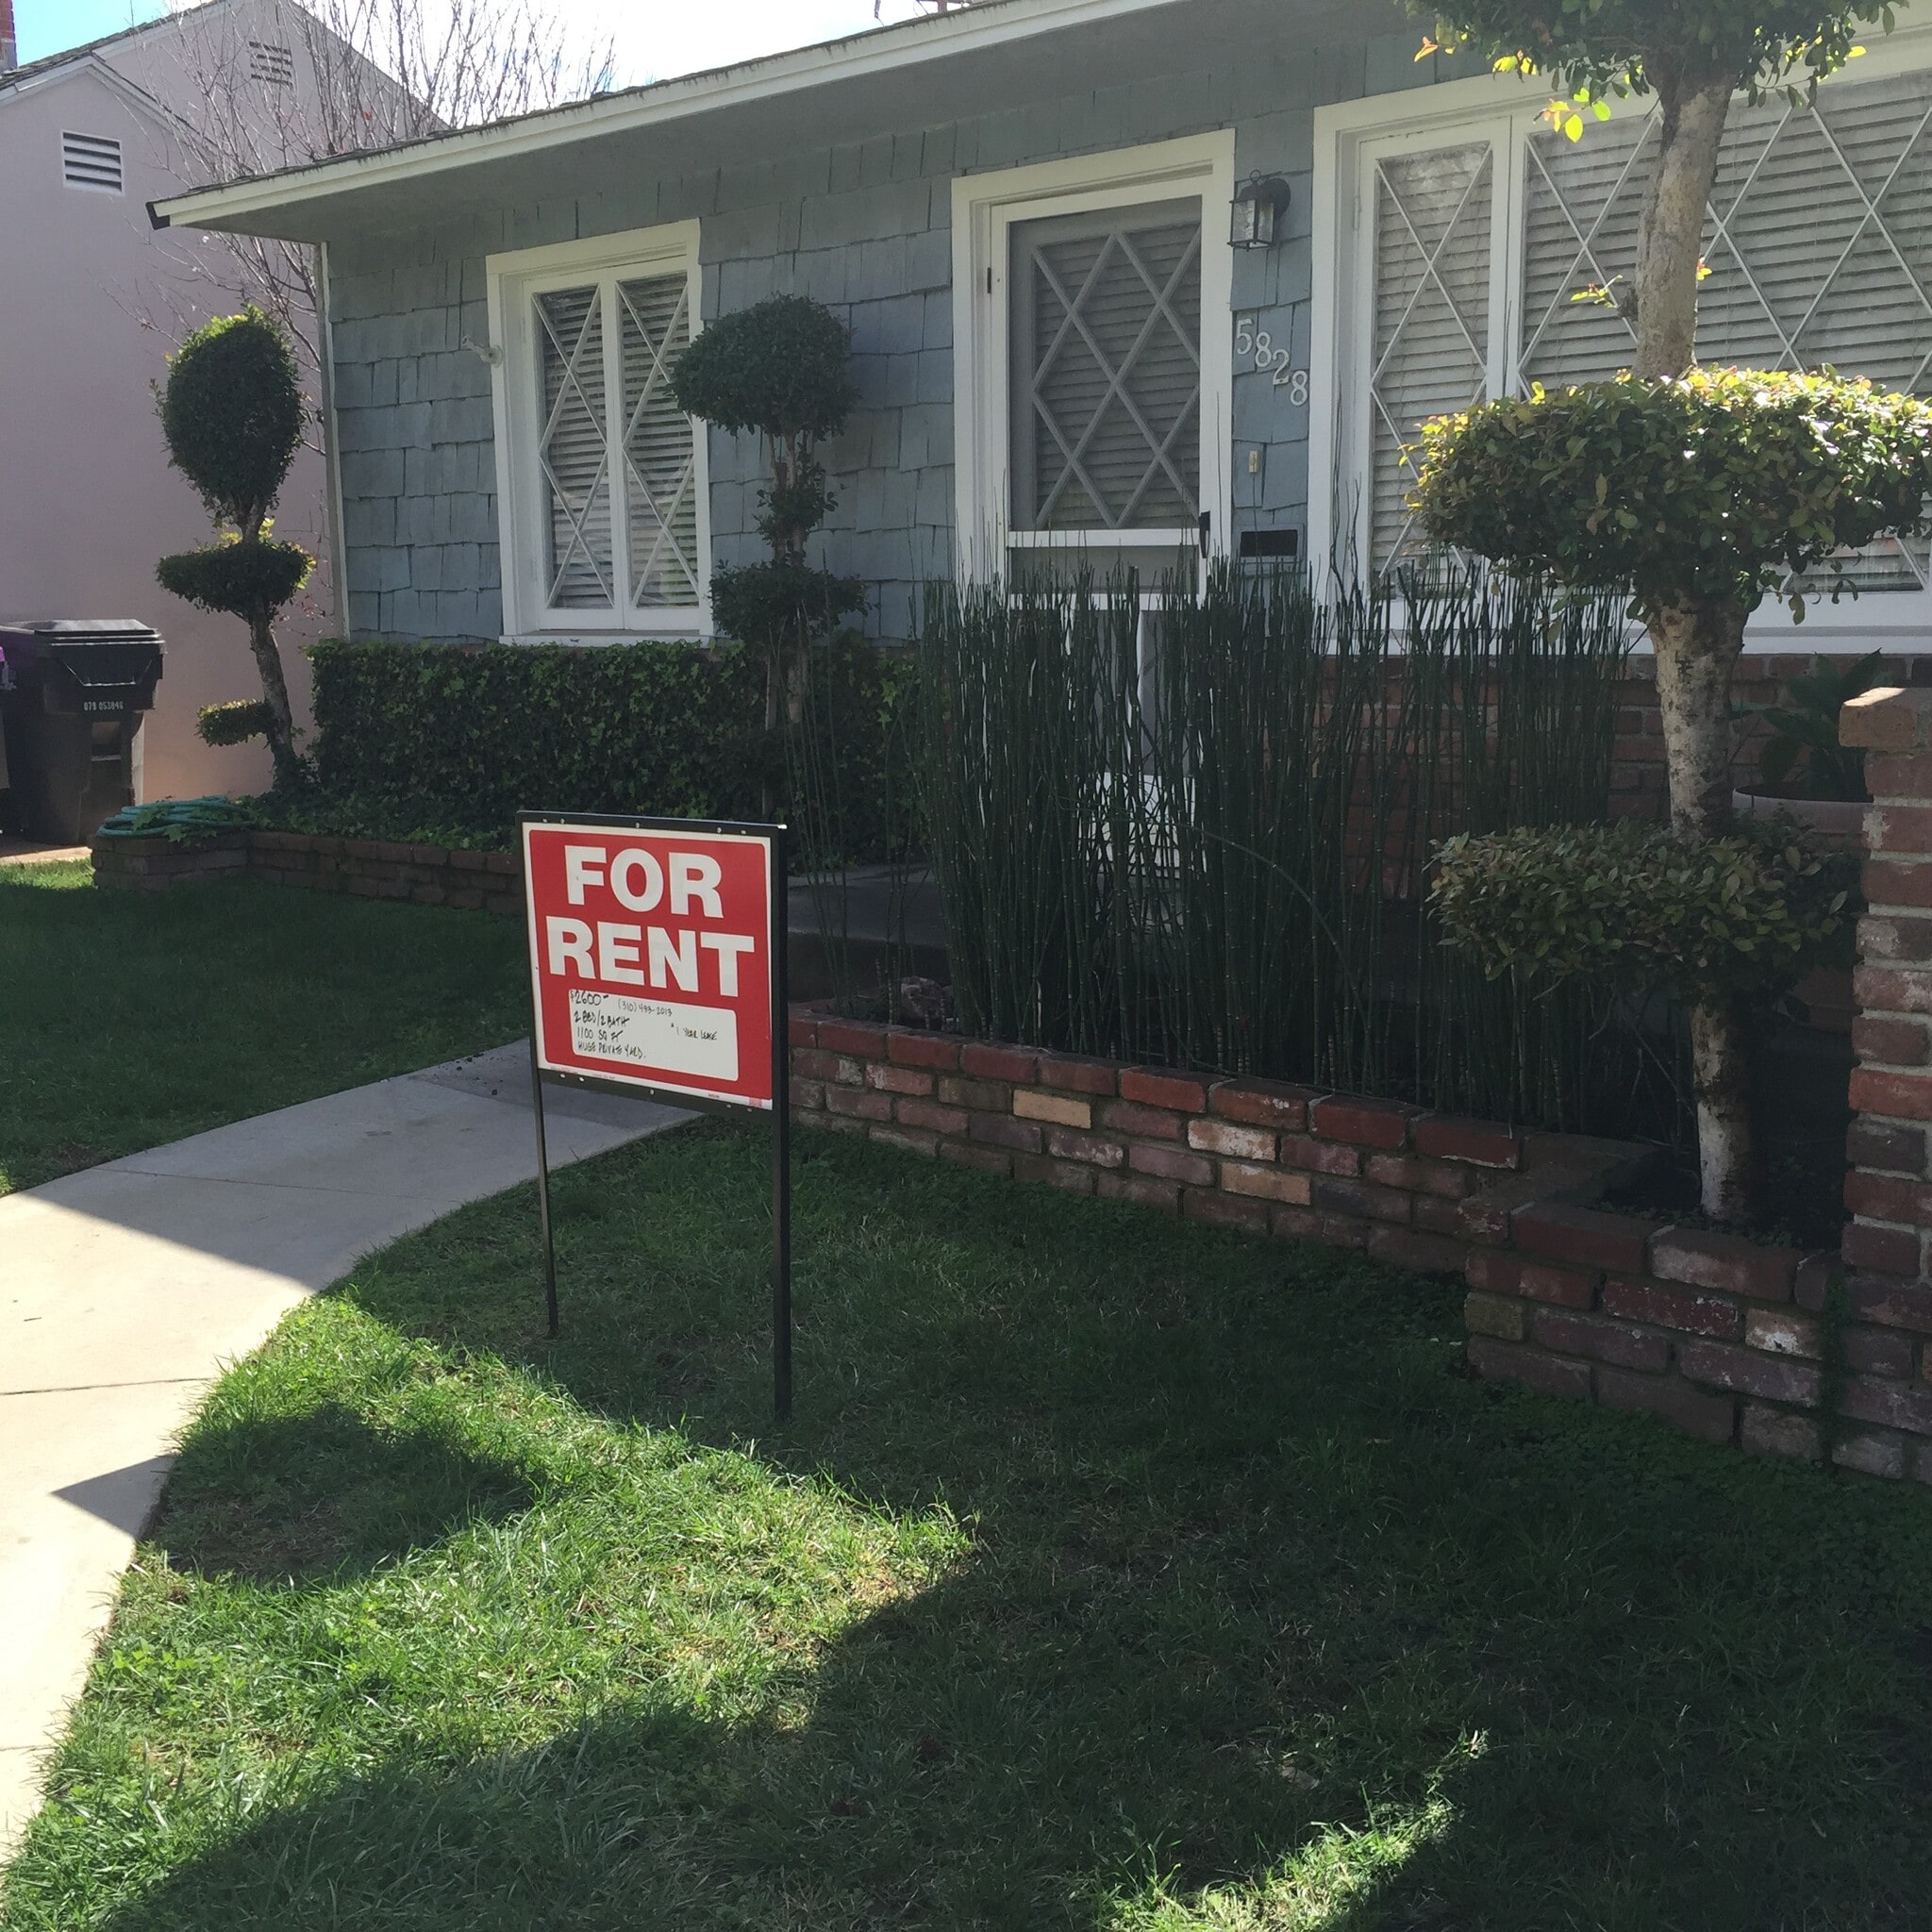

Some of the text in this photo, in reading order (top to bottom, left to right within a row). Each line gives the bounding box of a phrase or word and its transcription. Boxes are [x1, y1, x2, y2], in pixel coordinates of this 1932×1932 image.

[1232, 319, 1307, 406] 5828
[564, 845, 724, 918] FOR
[545, 915, 755, 997] RENT
[577, 1026, 593, 1039] 1100
